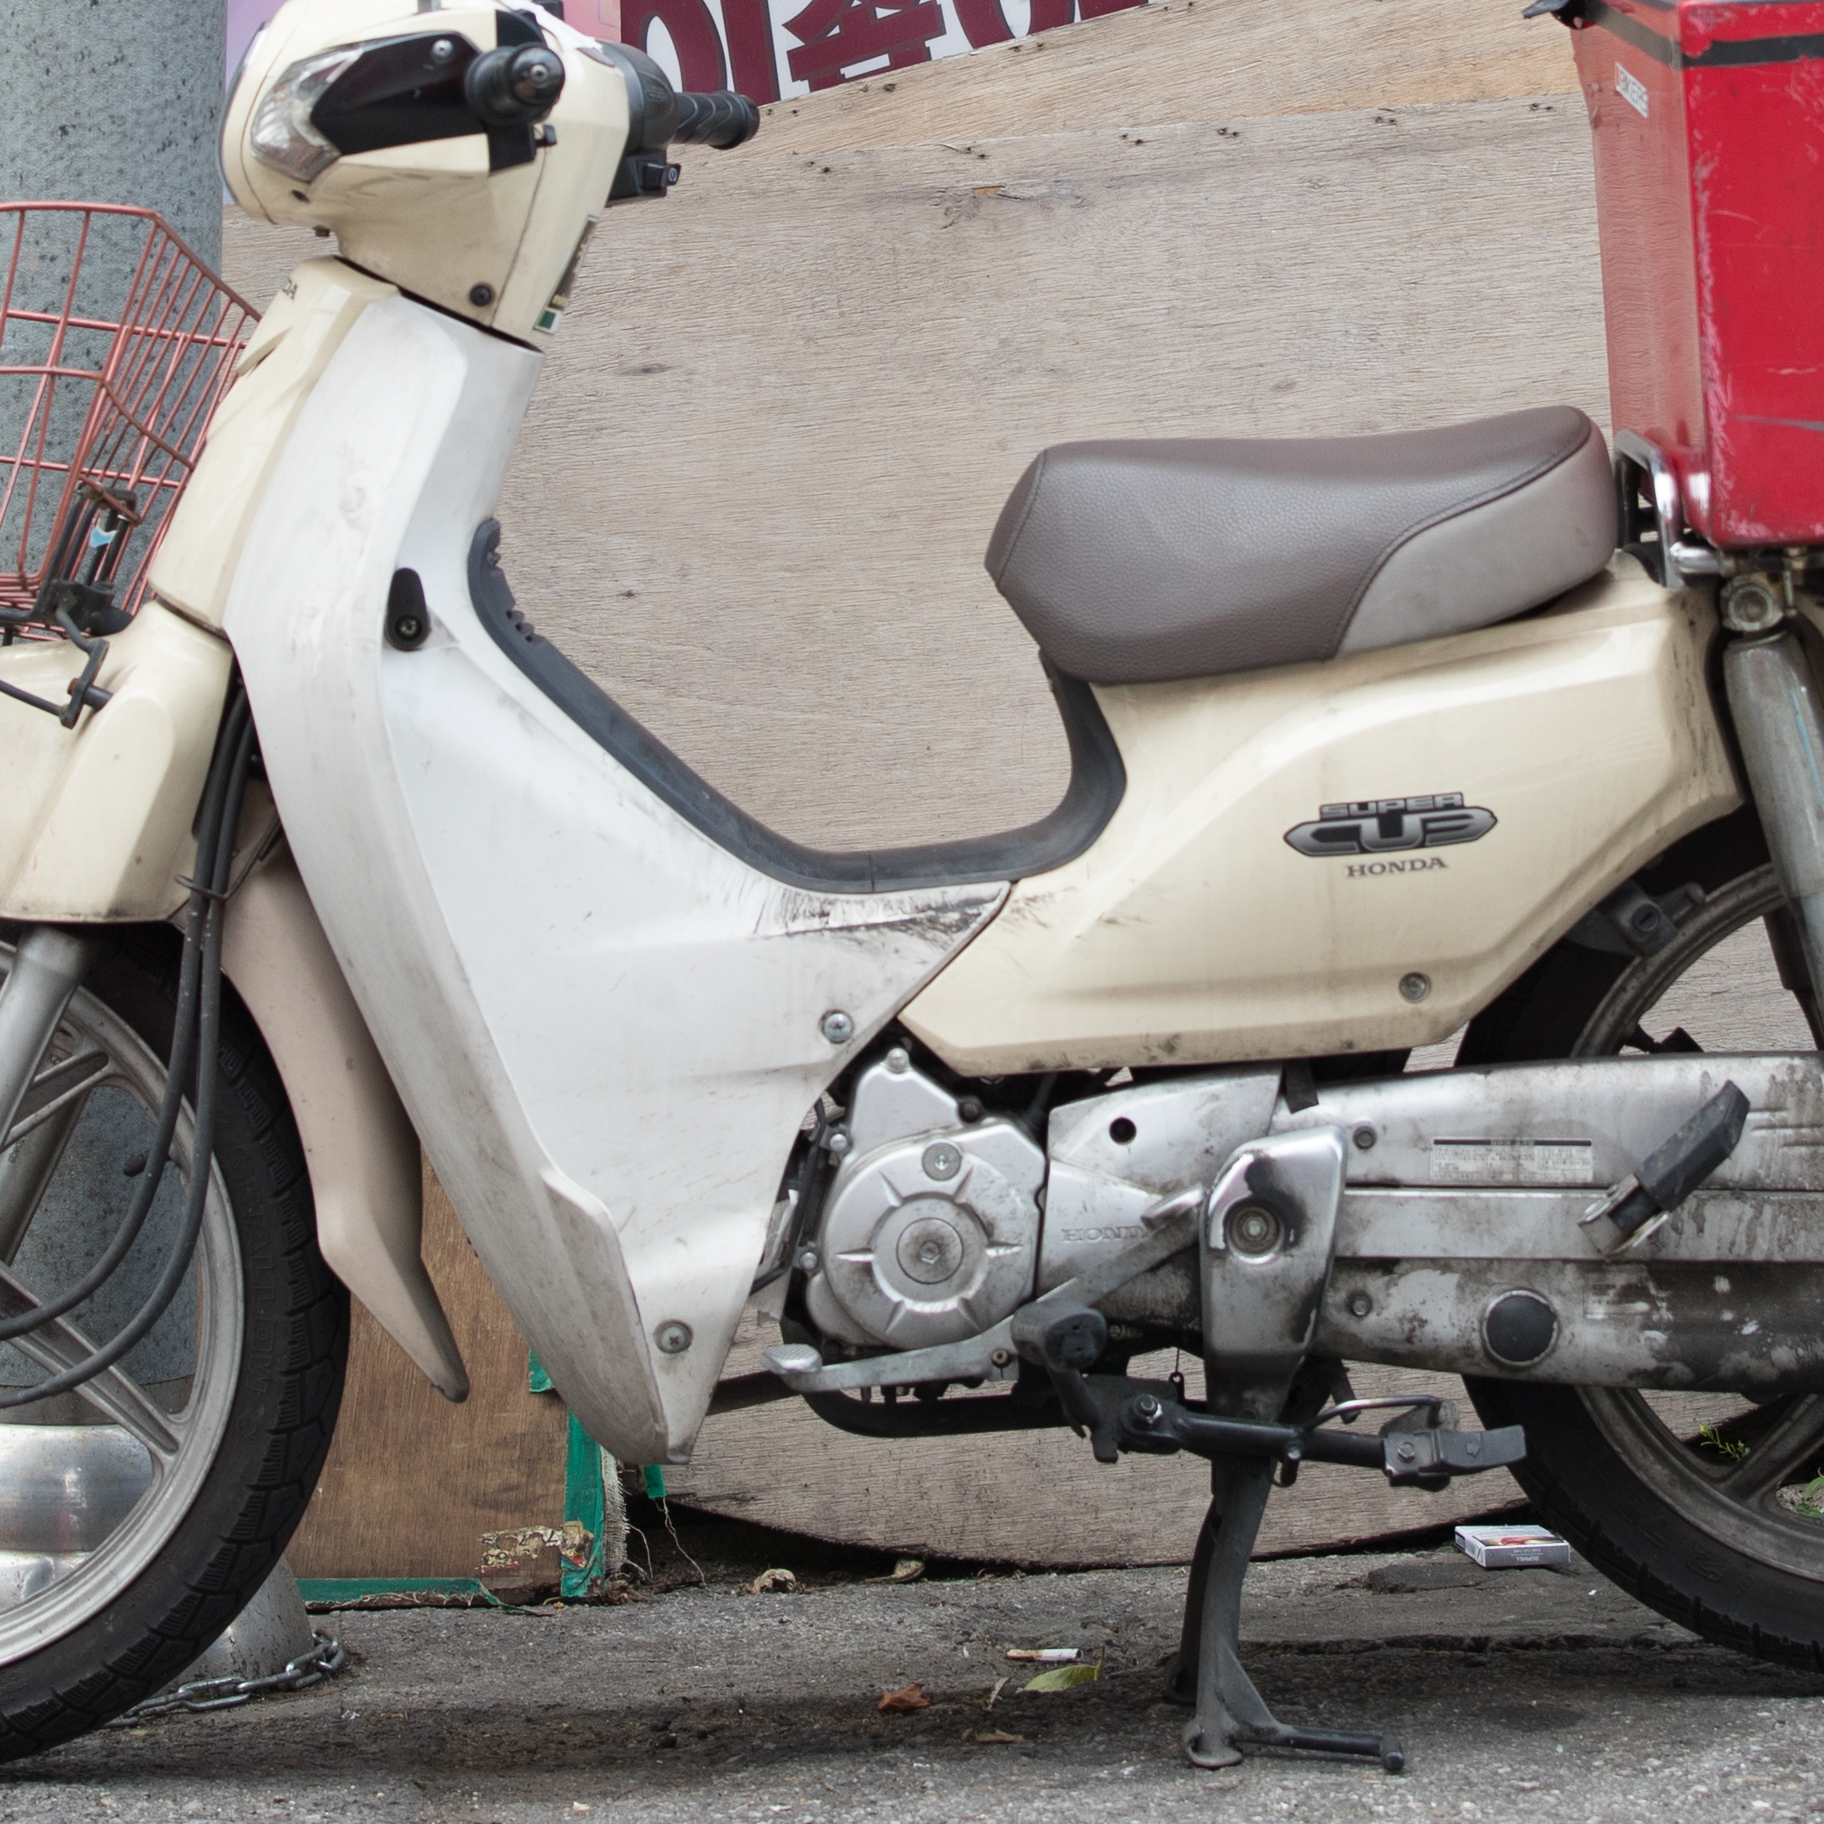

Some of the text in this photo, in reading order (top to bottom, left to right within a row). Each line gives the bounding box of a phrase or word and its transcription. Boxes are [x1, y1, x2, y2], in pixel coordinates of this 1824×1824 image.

[1321, 793, 1464, 819] SUPER
[1285, 806, 1498, 857] CUB
[1347, 857, 1448, 877] HONDA
